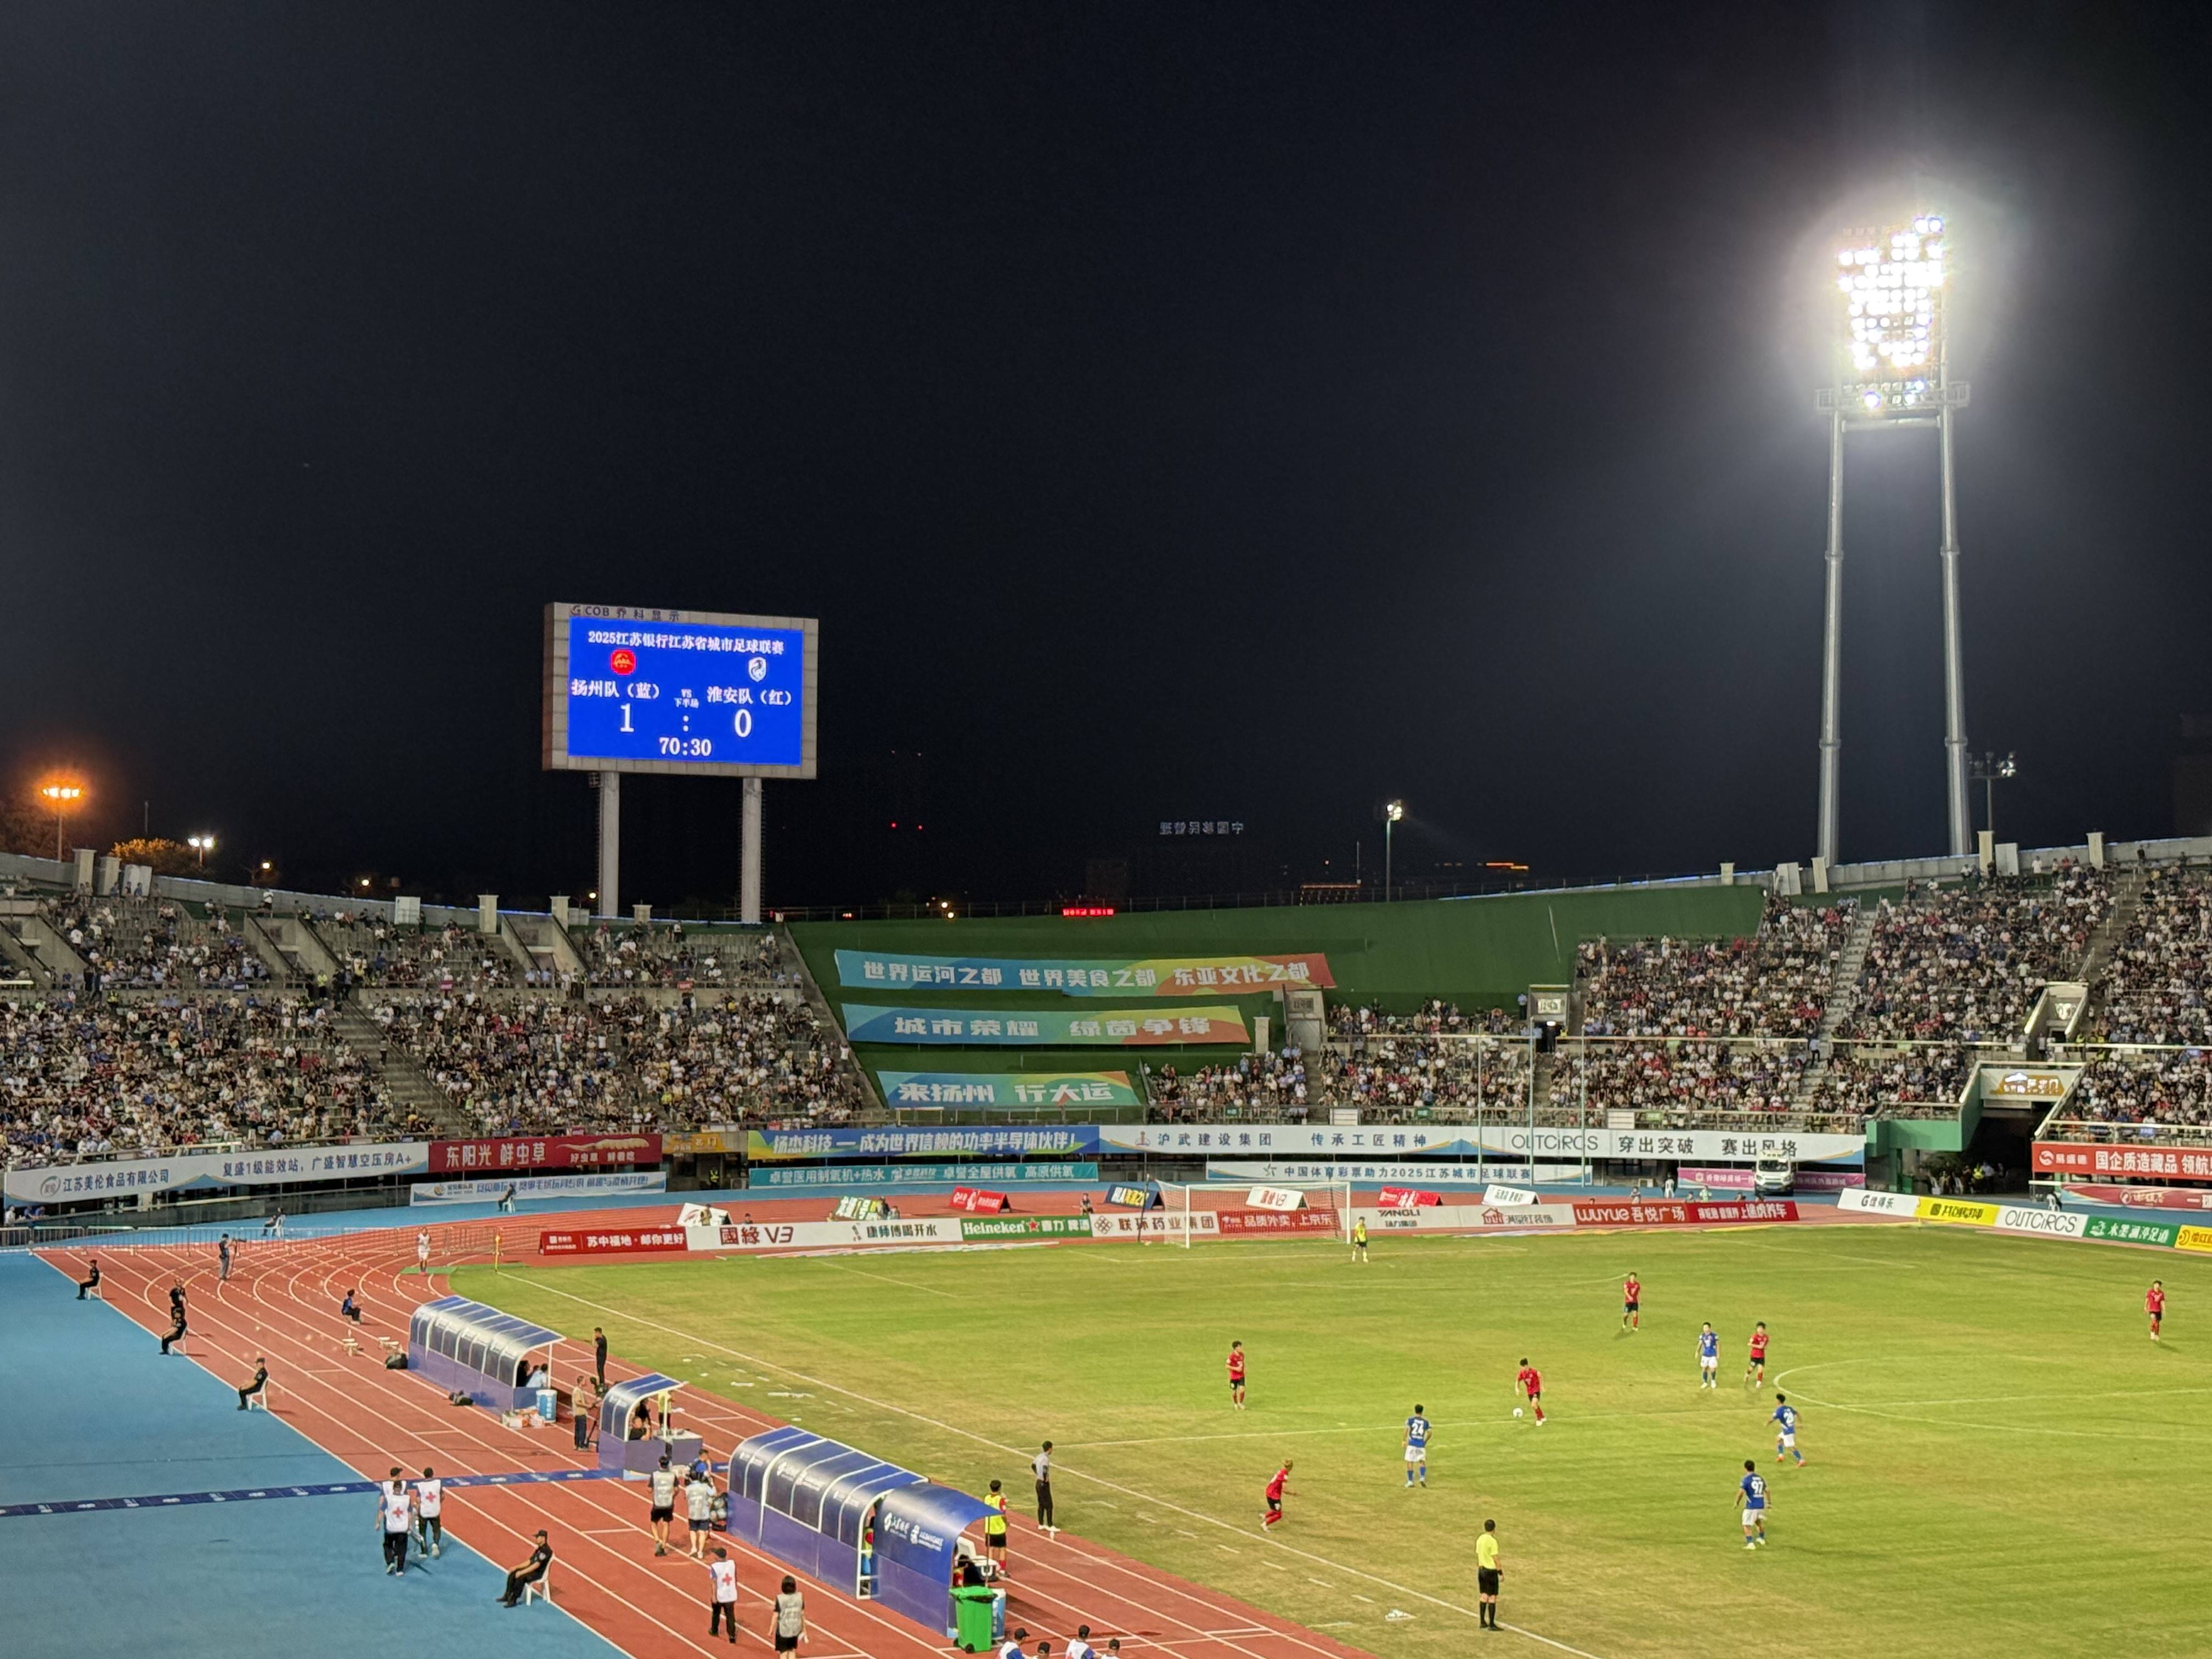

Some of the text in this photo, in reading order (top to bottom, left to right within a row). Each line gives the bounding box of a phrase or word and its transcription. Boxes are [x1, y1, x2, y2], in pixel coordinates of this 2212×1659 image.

[588, 631, 785, 656] 2025江苏银行江苏省城市足球联赛
[620, 703, 634, 732] 1
[734, 709, 752, 737] 0
[659, 737, 712, 757] 70:30
[864, 961, 1310, 988] 世界运河之都 世界美食之都 东亚文化之都
[895, 1017, 1210, 1037] 城市荣耀 绿茵争锋
[899, 1082, 1114, 1103] 来扬州 行大运
[1158, 1133, 1426, 1147] 沪武建设集团 传承工匠精神
[1618, 1136, 1797, 1156] 穿出突破 赛出风格
[446, 1142, 546, 1169] 东阳光 鲜虫草
[2095, 1150, 2212, 1176] 国企质造藏品 领航
[63, 1169, 170, 1193] 江苏美伦食品有限公司
[1632, 1206, 1685, 1222] 吾悦广场
[764, 1226, 794, 1244] V3
[963, 1220, 1025, 1235] Heineken
[1412, 1423, 1424, 1436] 24
[1751, 1481, 1763, 1494] 97
